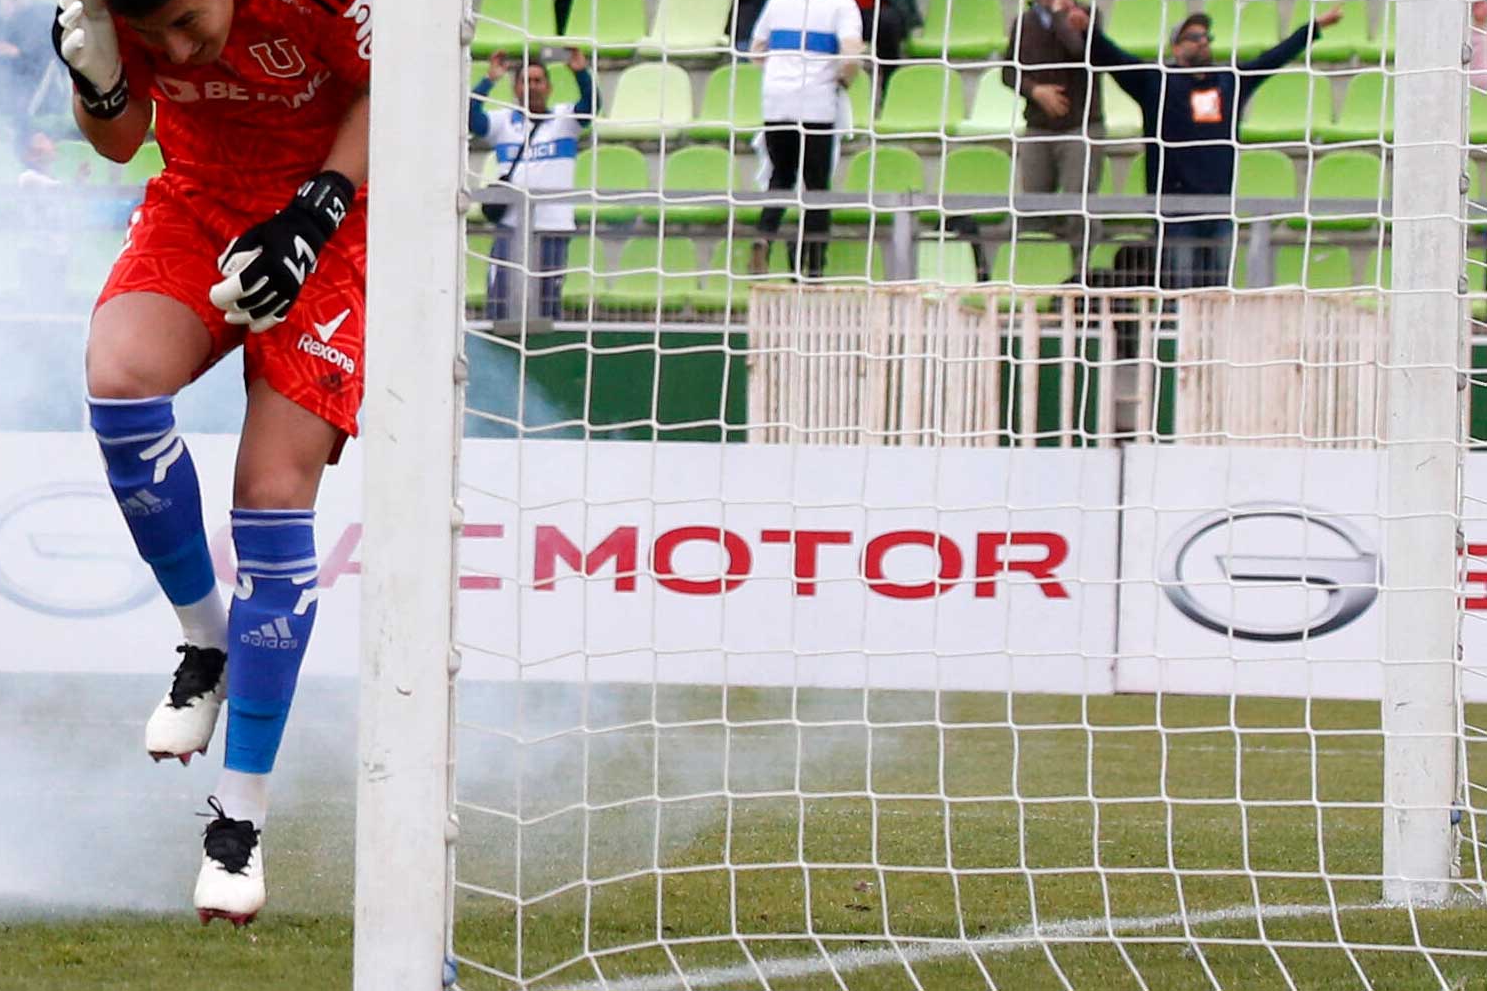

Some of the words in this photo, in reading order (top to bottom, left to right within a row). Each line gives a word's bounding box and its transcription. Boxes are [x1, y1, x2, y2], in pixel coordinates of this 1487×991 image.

[297, 332, 355, 375] Rexona
[532, 524, 1071, 600] MOTOR
[240, 630, 298, 649] adidas
